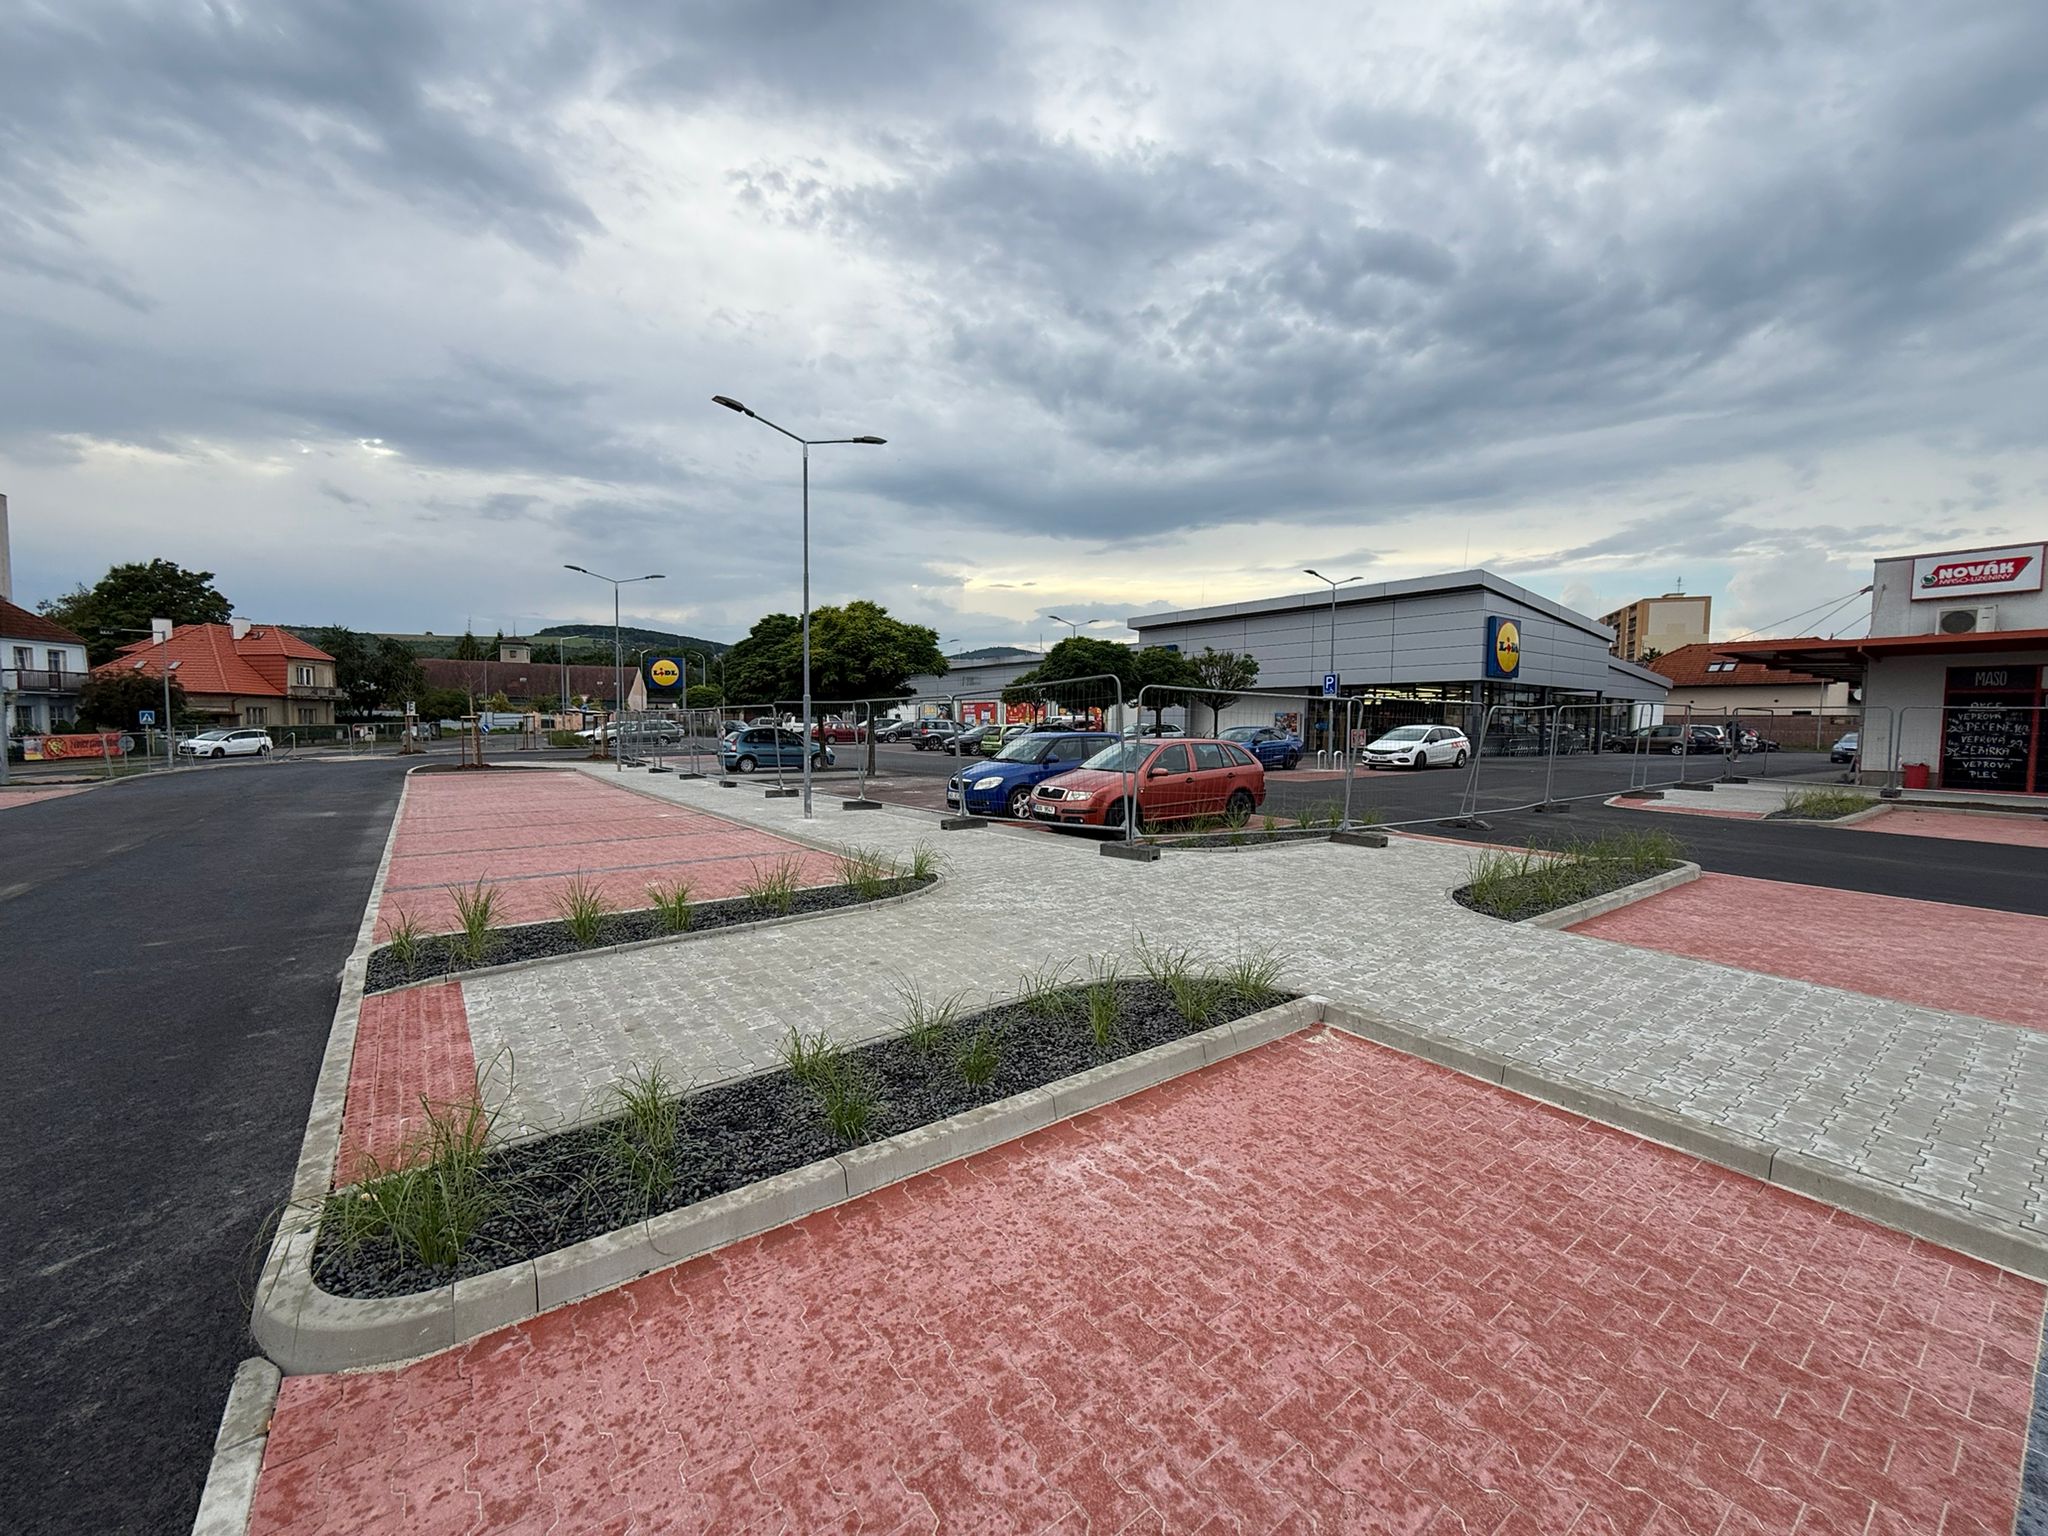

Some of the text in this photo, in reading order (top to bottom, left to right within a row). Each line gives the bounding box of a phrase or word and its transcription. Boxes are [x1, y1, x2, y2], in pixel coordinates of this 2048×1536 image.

[1939, 561, 2014, 579] NOVÁK
[653, 668, 677, 677] LIDL
[1975, 671, 2007, 686] MASO
[1326, 677, 1334, 689] P
[1969, 770, 1999, 779] PLEC
